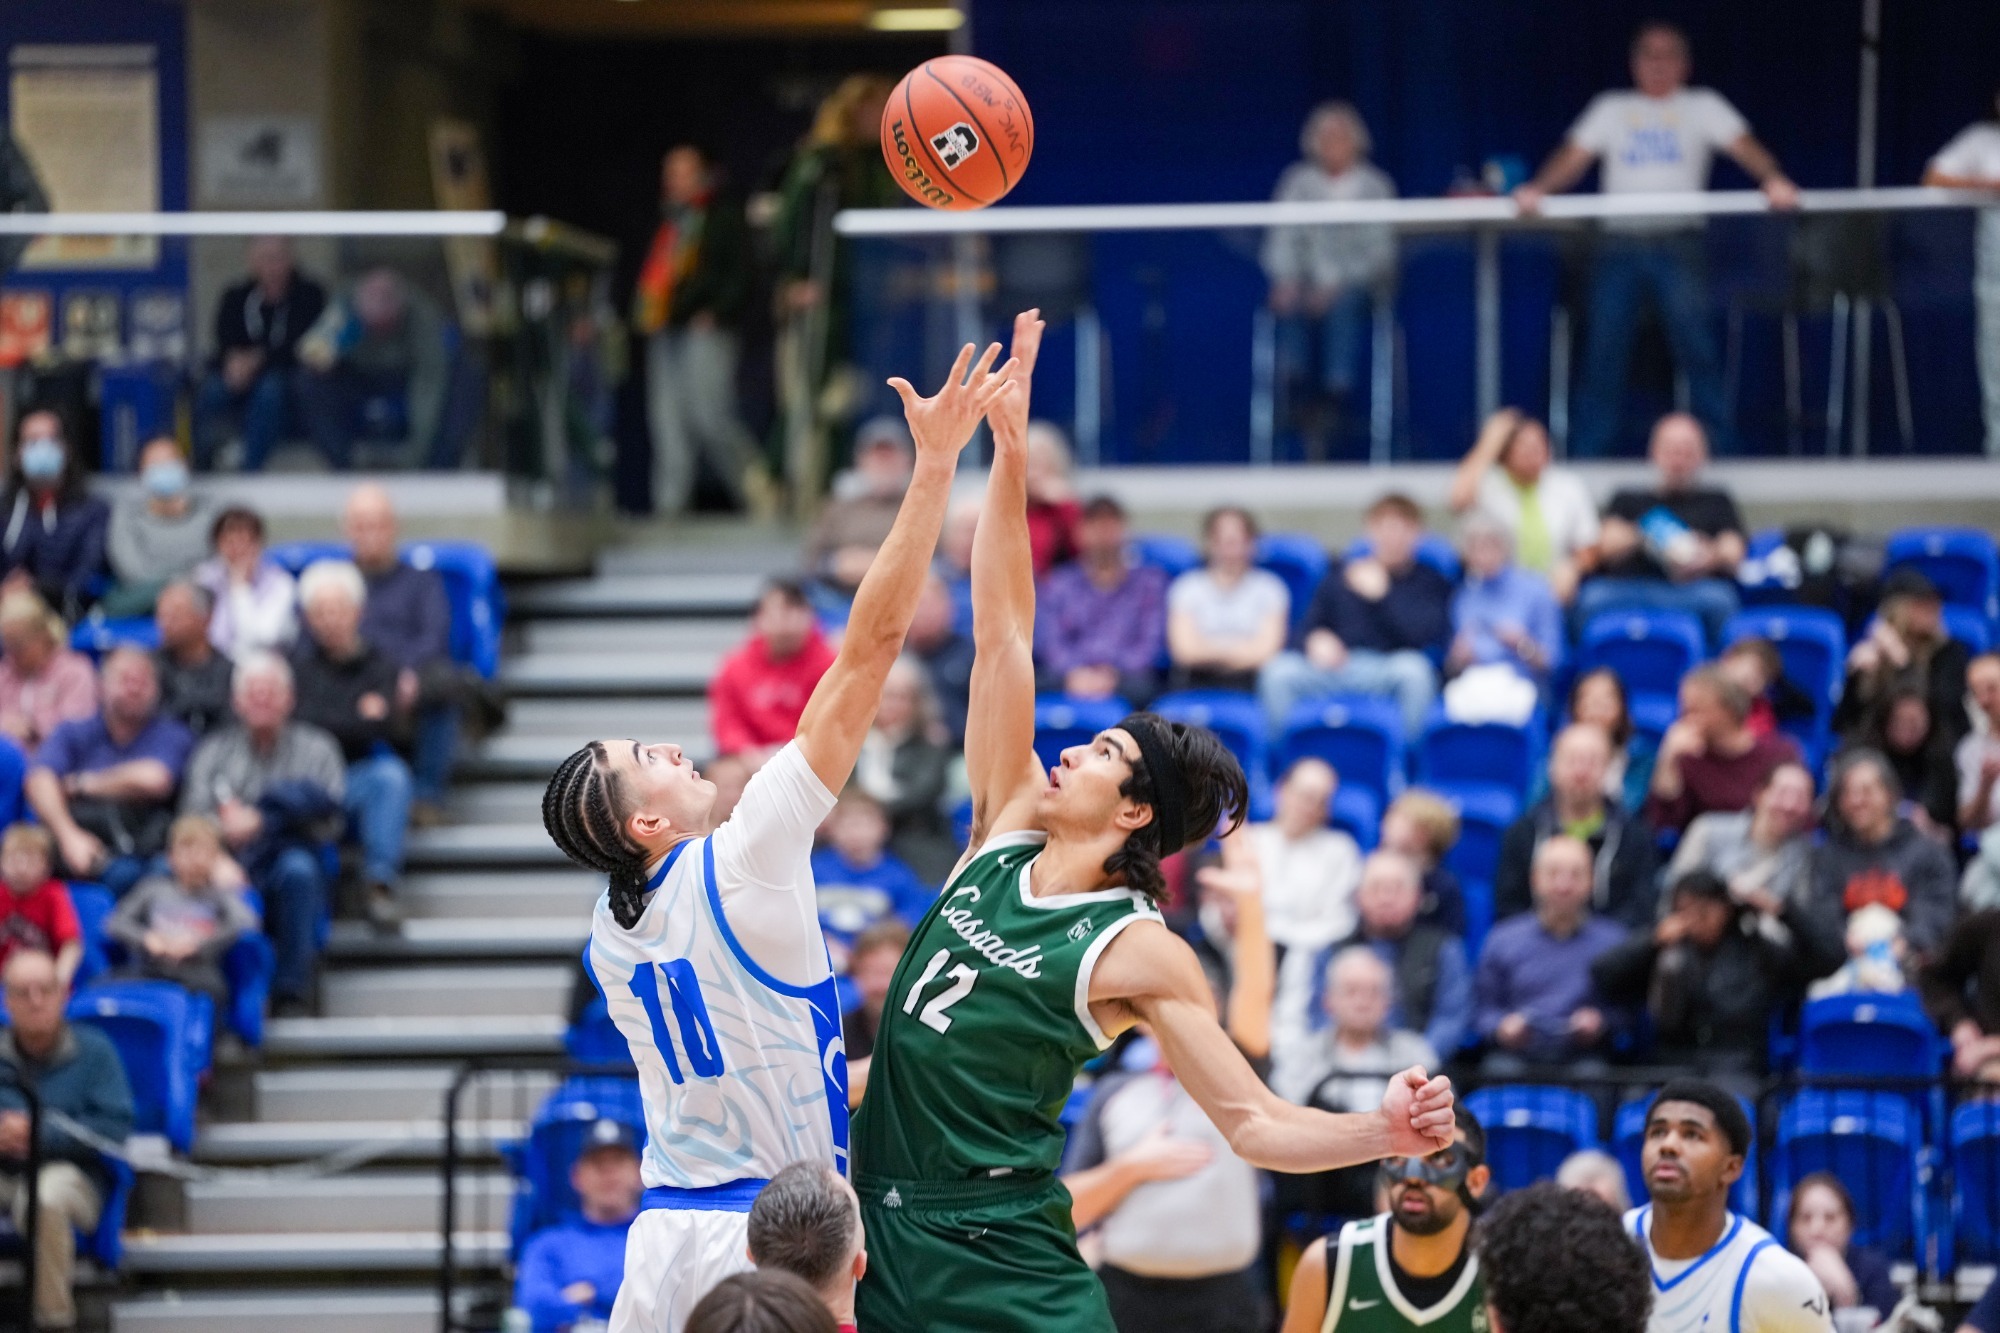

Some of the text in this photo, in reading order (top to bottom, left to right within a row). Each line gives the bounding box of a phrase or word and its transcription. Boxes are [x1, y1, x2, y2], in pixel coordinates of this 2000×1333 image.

[892, 118, 955, 206] Wilson
[627, 958, 725, 1086] 10
[902, 948, 979, 1035] 12
